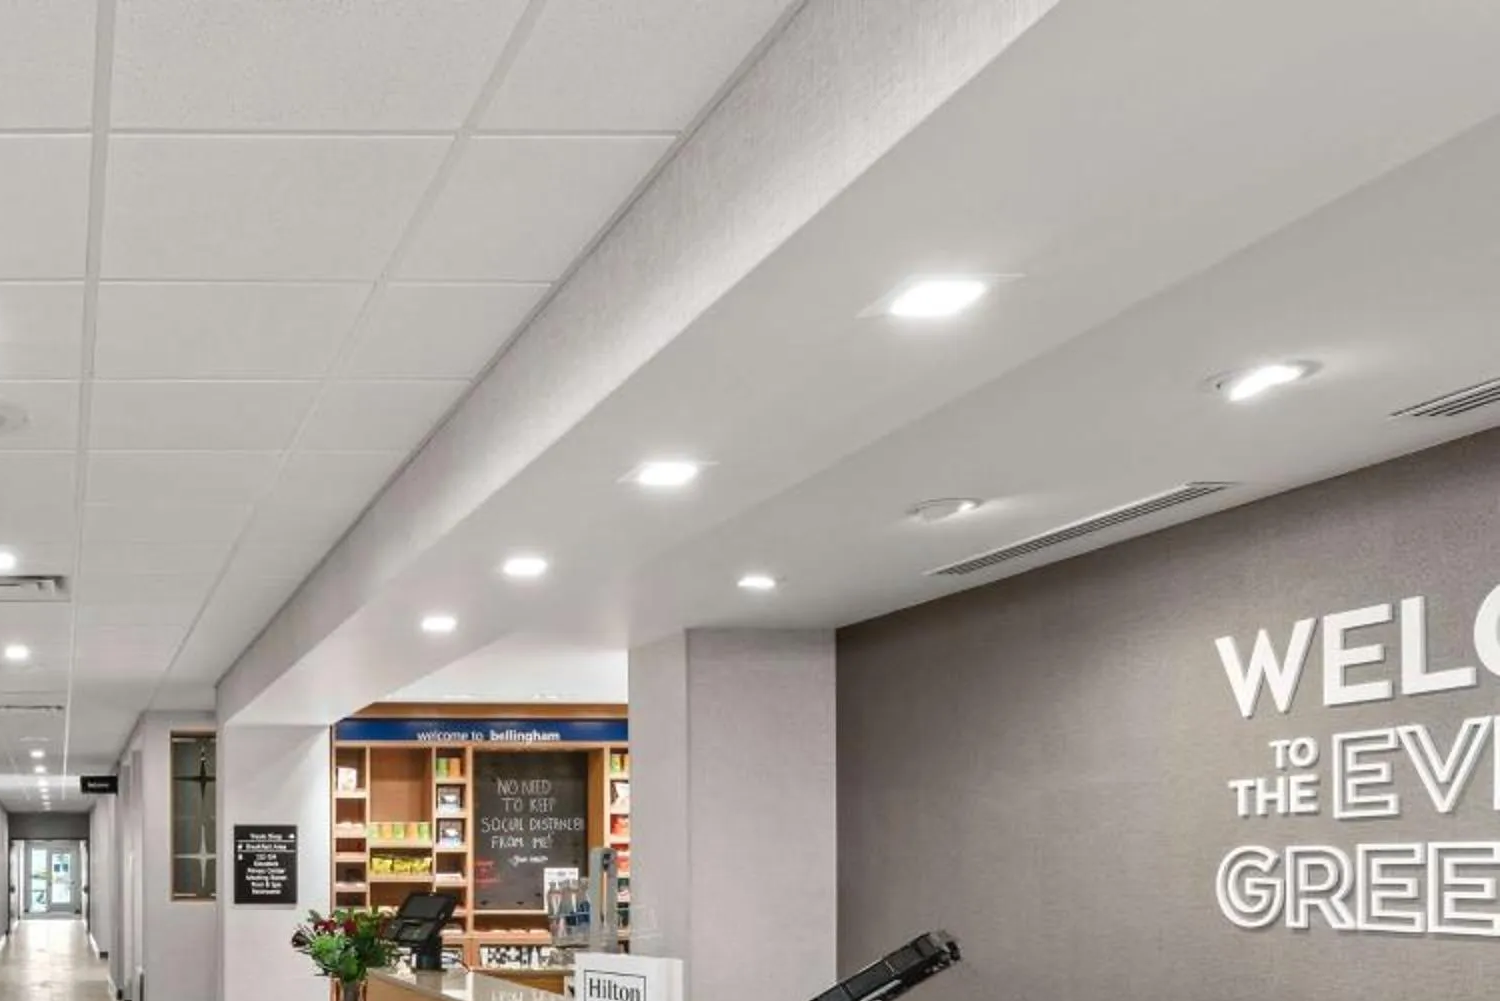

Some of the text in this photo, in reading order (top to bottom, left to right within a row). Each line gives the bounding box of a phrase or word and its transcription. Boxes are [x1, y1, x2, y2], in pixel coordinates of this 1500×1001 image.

[416, 728, 561, 744] welcome to bellingham
[1269, 736, 1319, 768] TO
[1228, 715, 1500, 819] THE EV
[497, 777, 552, 796] NO NEED
[501, 797, 557, 813] TO KEEP
[481, 816, 524, 833] SOCIAL
[491, 835, 524, 849] FROM
